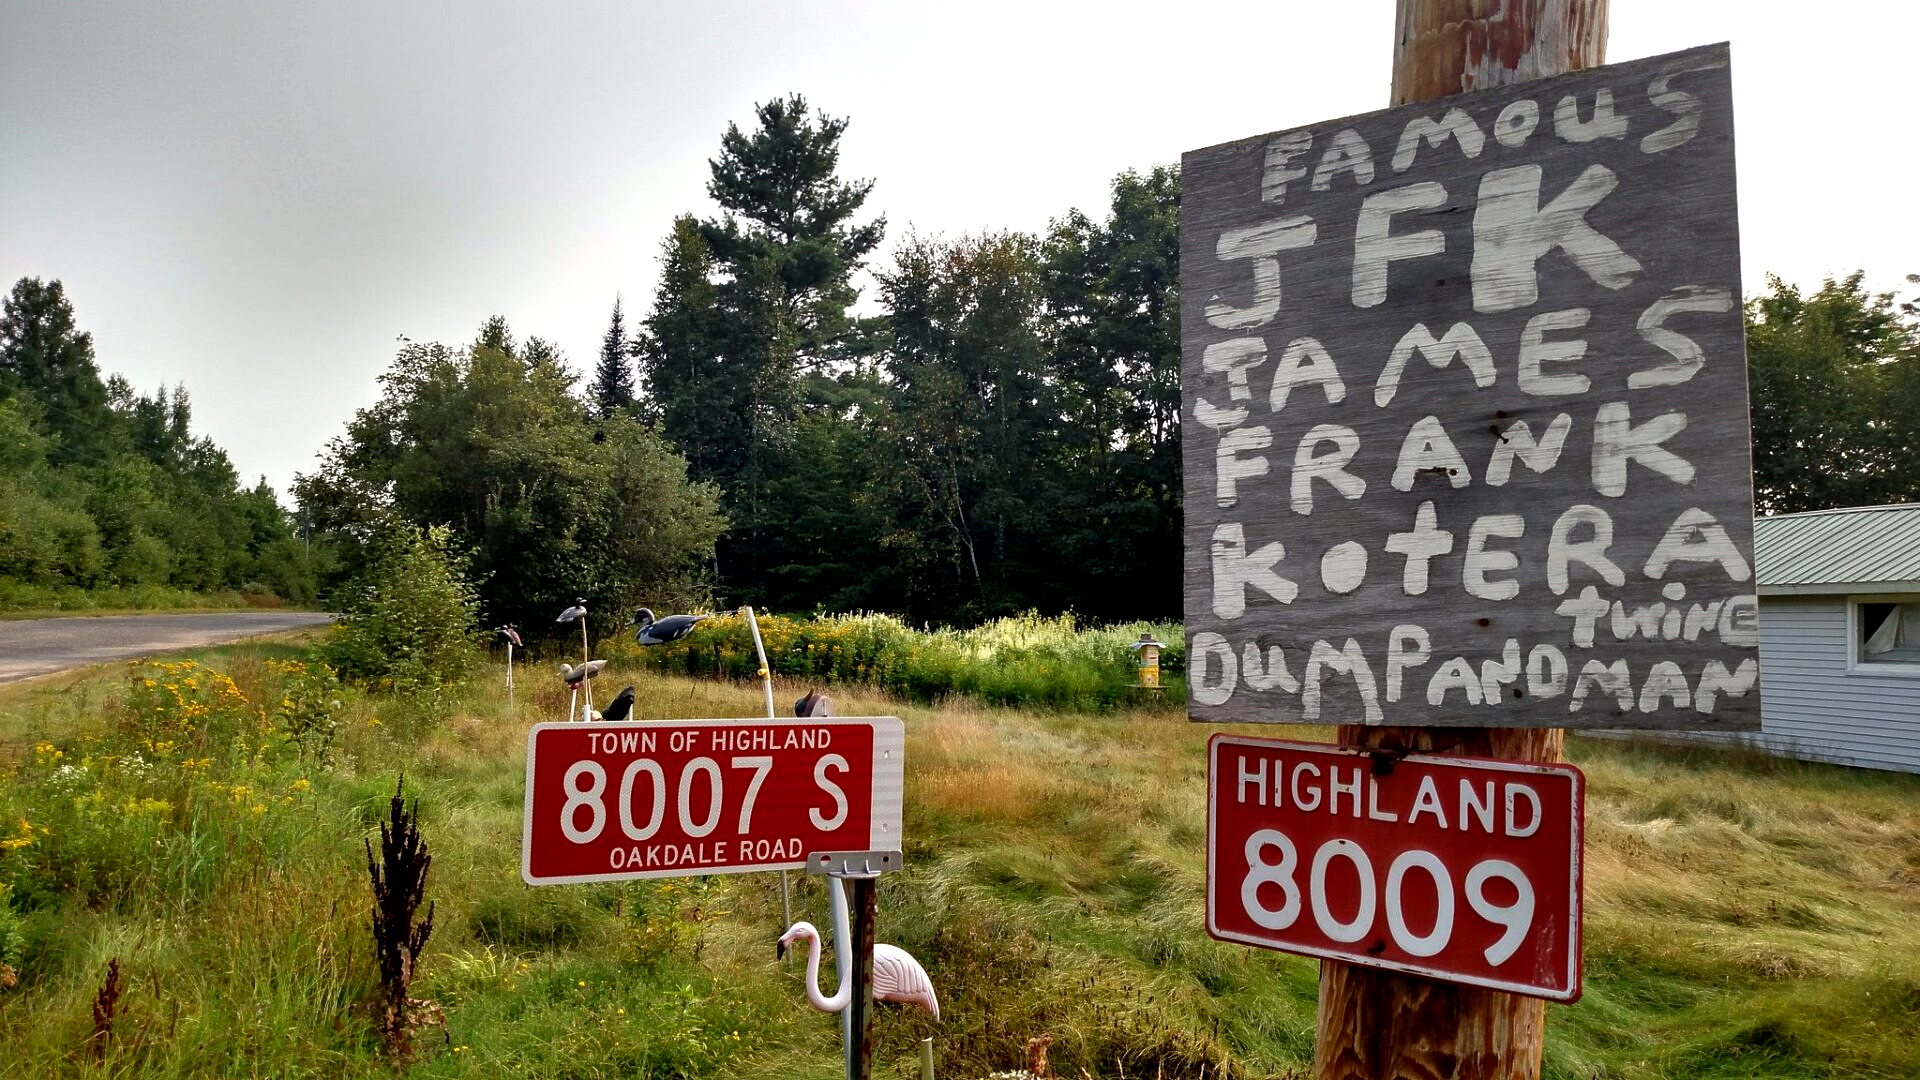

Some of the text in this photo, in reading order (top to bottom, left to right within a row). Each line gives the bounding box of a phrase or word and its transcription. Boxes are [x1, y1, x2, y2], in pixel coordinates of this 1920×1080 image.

[1205, 164, 1643, 330] JFK
[1193, 285, 1733, 428] JAMES
[1217, 402, 1696, 515] FRANK
[588, 729, 831, 754] TOWN OF HIGHLAND
[560, 753, 849, 844] 8007 S
[1238, 756, 1542, 837] HIGHLAND
[610, 838, 802, 868] OAKDALE ROAD
[1241, 829, 1535, 967] 8009
